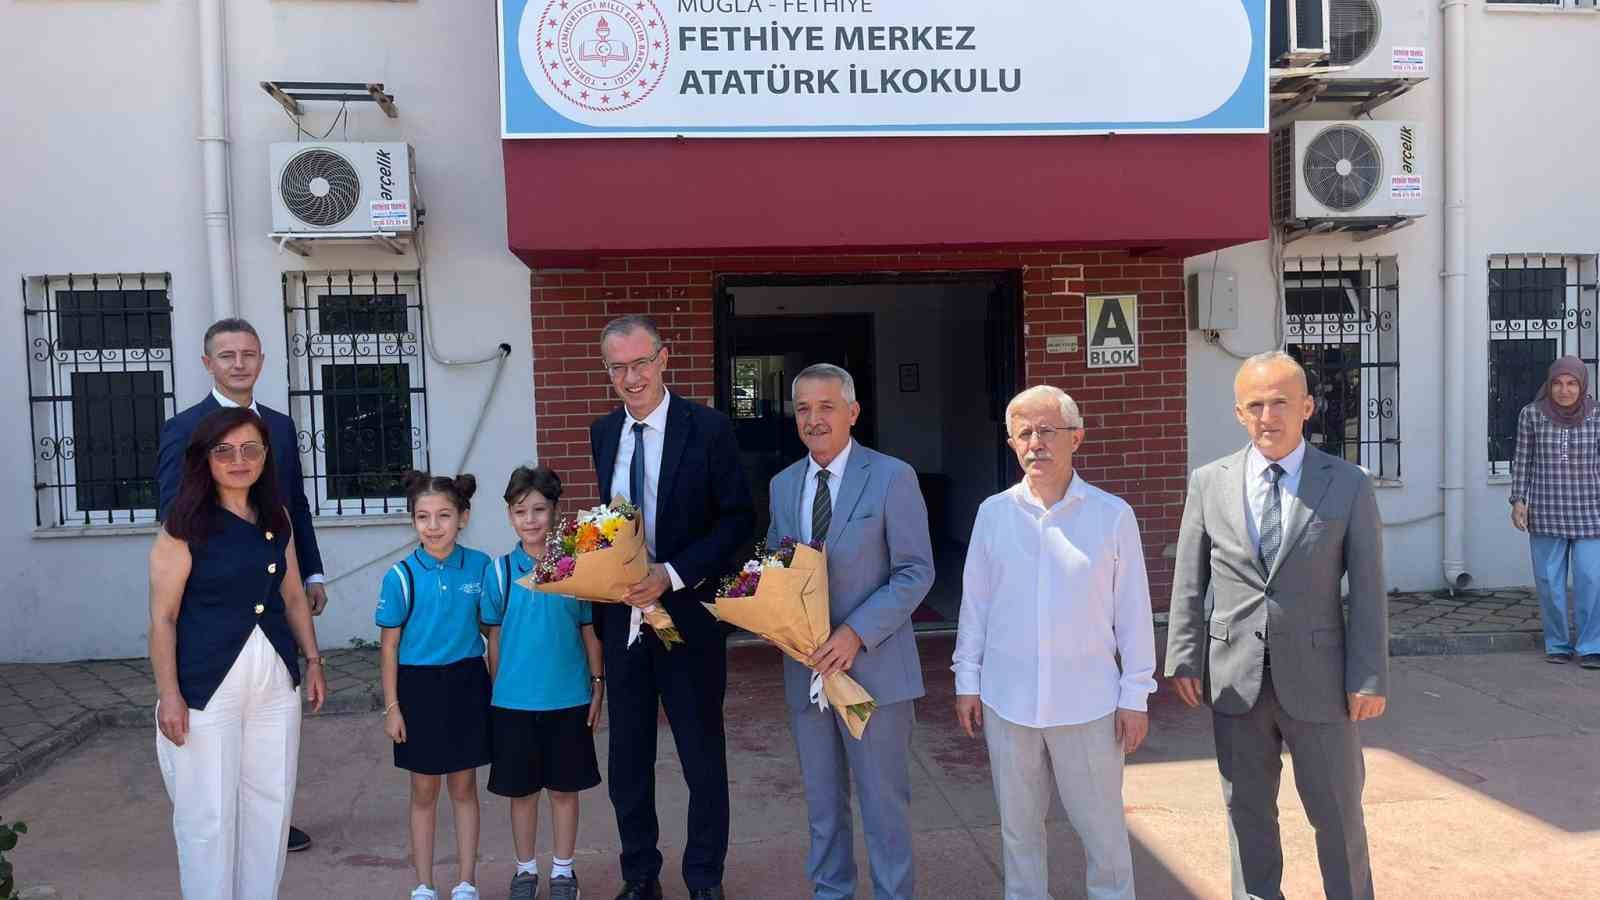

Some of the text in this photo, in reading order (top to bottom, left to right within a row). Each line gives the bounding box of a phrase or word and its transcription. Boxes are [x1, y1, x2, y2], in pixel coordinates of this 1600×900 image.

[678, 20, 976, 51] FETHİYE MERKEZ
[679, 63, 1022, 95] ATATÜRK İLKOKULU
[1399, 125, 1415, 174] arçelik
[376, 148, 395, 201] arçelik
[1089, 298, 1135, 347] A
[1090, 350, 1135, 366] BLOK
